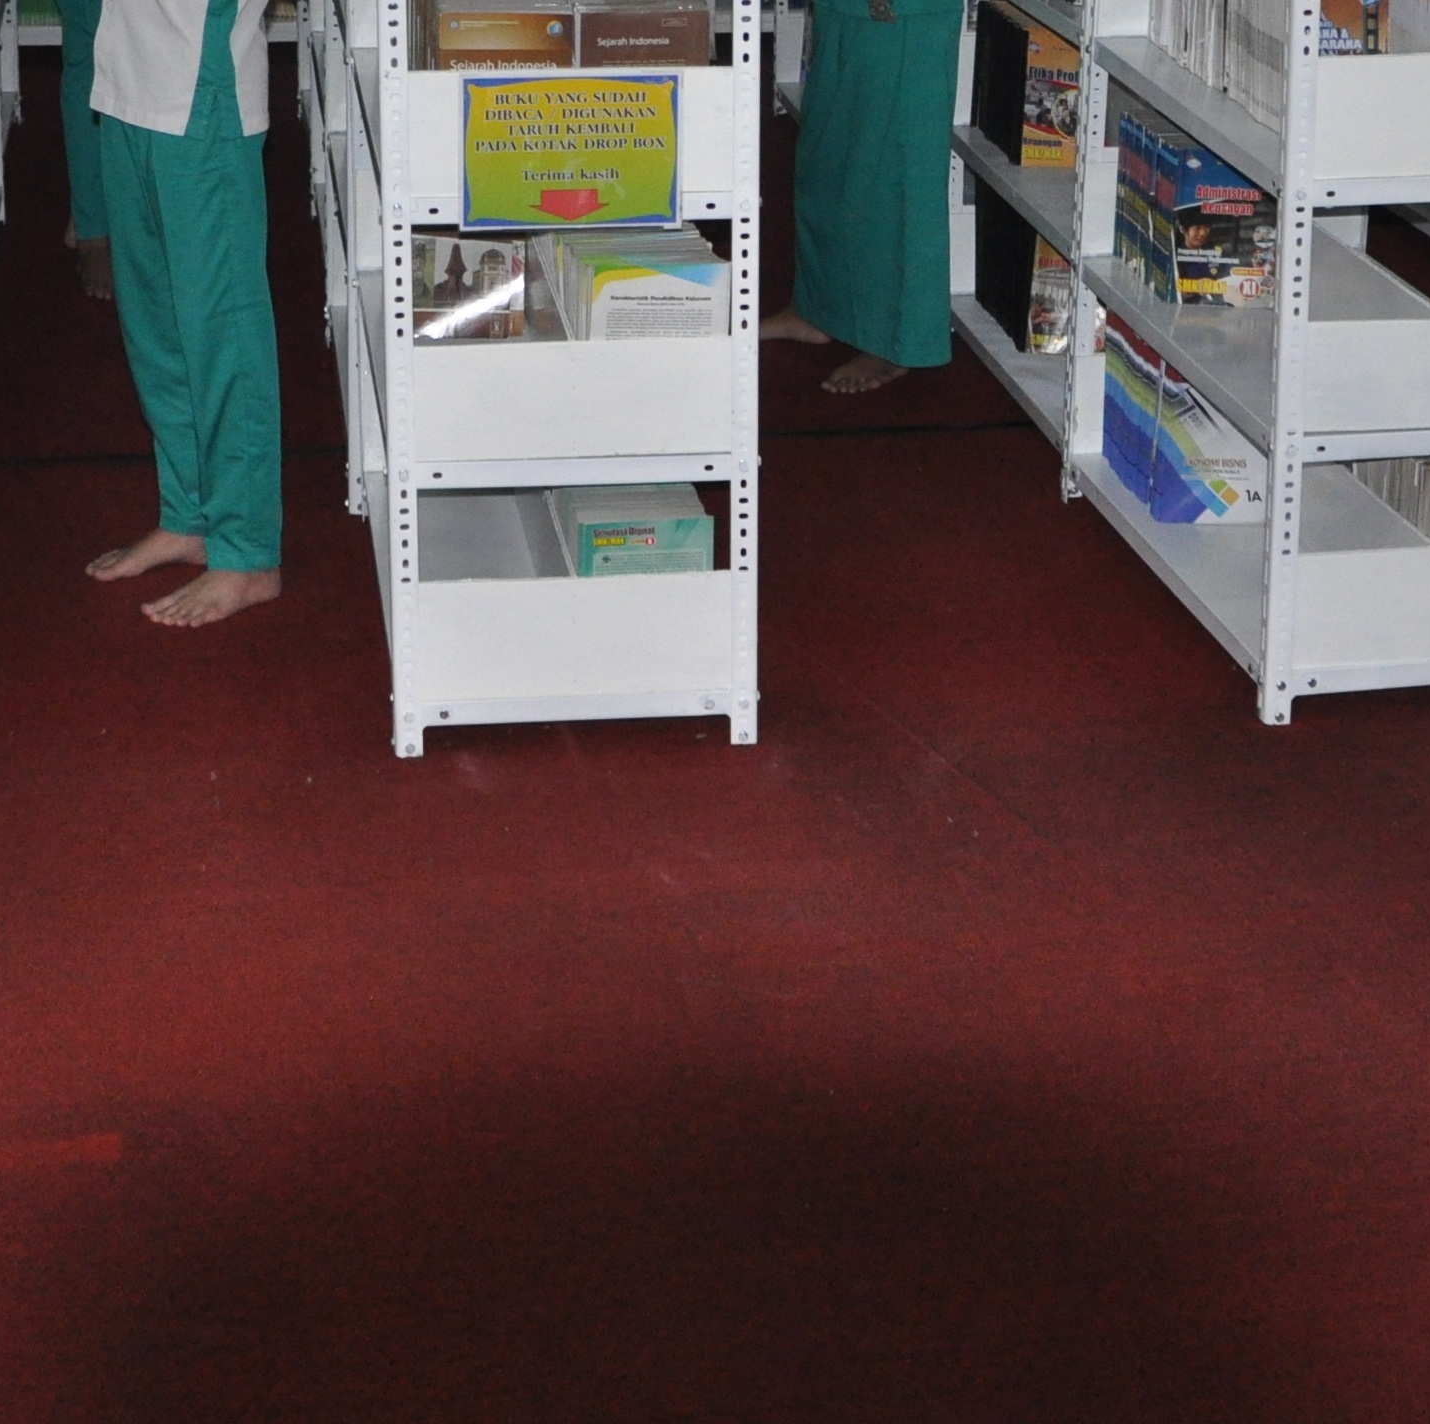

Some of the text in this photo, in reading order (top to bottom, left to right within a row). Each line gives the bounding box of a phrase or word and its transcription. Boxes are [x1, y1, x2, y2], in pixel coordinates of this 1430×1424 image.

[597, 36, 670, 47] Sejarah Indonesia
[449, 59, 557, 71] Sejarah Indonesia
[495, 91, 647, 106] BUKU YANG SUDAH
[485, 109, 543, 121] DIBACA
[561, 107, 657, 119] DIGUNAKAN
[507, 122, 636, 136] TARUH KEMBALI
[475, 137, 667, 153] PADA KOTAK DROP BOX
[521, 167, 620, 183] Terima kasih
[1195, 185, 1262, 201] Administrasi
[1201, 202, 1254, 216] Keuangan
[1241, 280, 1257, 295] XI
[1221, 458, 1248, 468] BISNIS
[1246, 489, 1262, 502] 1A
